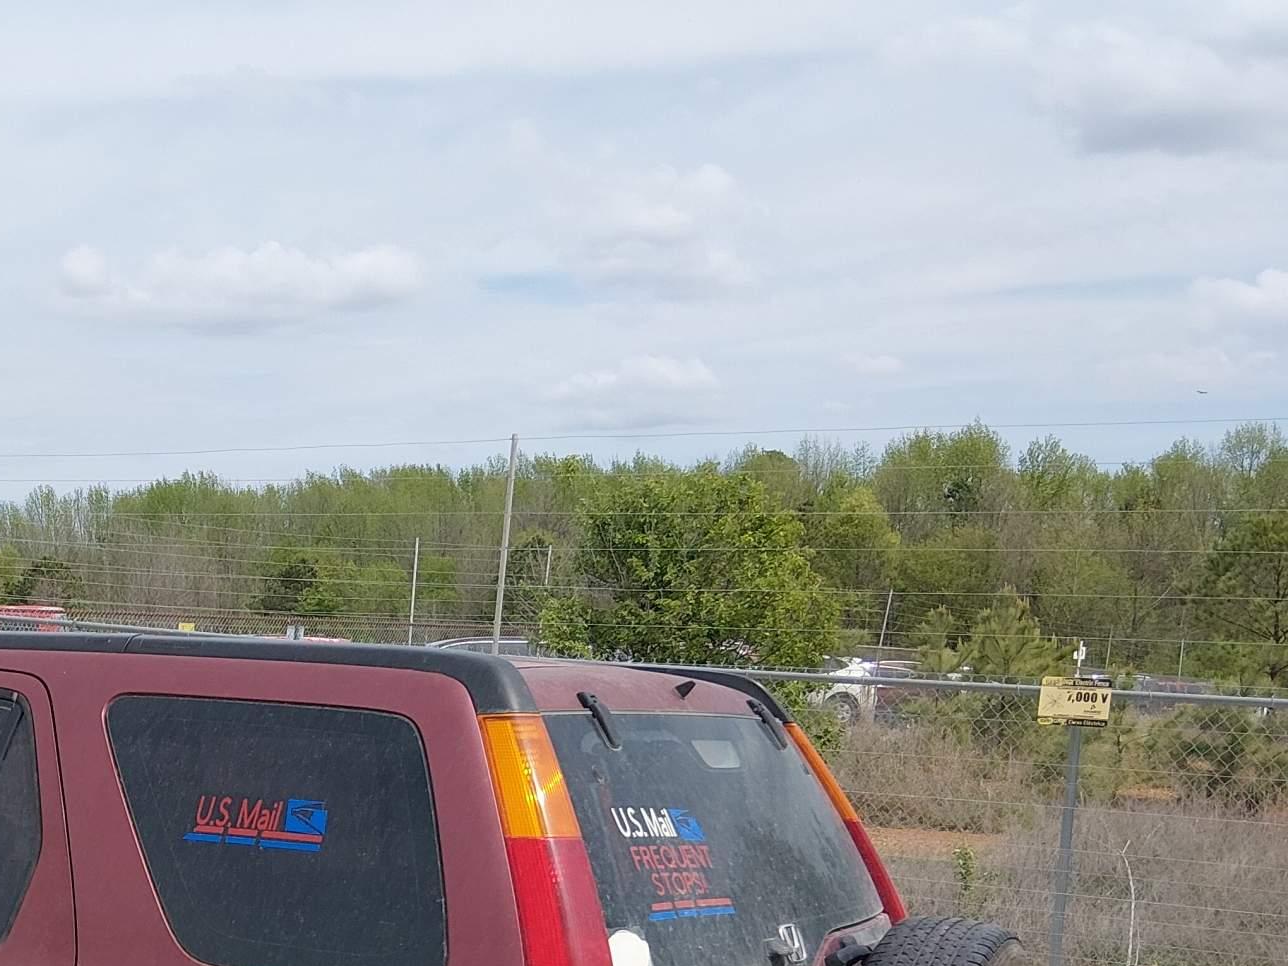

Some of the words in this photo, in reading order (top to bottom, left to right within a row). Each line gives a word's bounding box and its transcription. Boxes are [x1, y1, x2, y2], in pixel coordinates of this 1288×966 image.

[1101, 693, 1109, 704] V
[196, 795, 233, 828] U.S.
[236, 798, 285, 831] Mail
[610, 807, 649, 838] U.S.
[639, 807, 679, 837] Mail
[629, 845, 713, 872] FREQUENT
[650, 871, 710, 896] STOPS!
